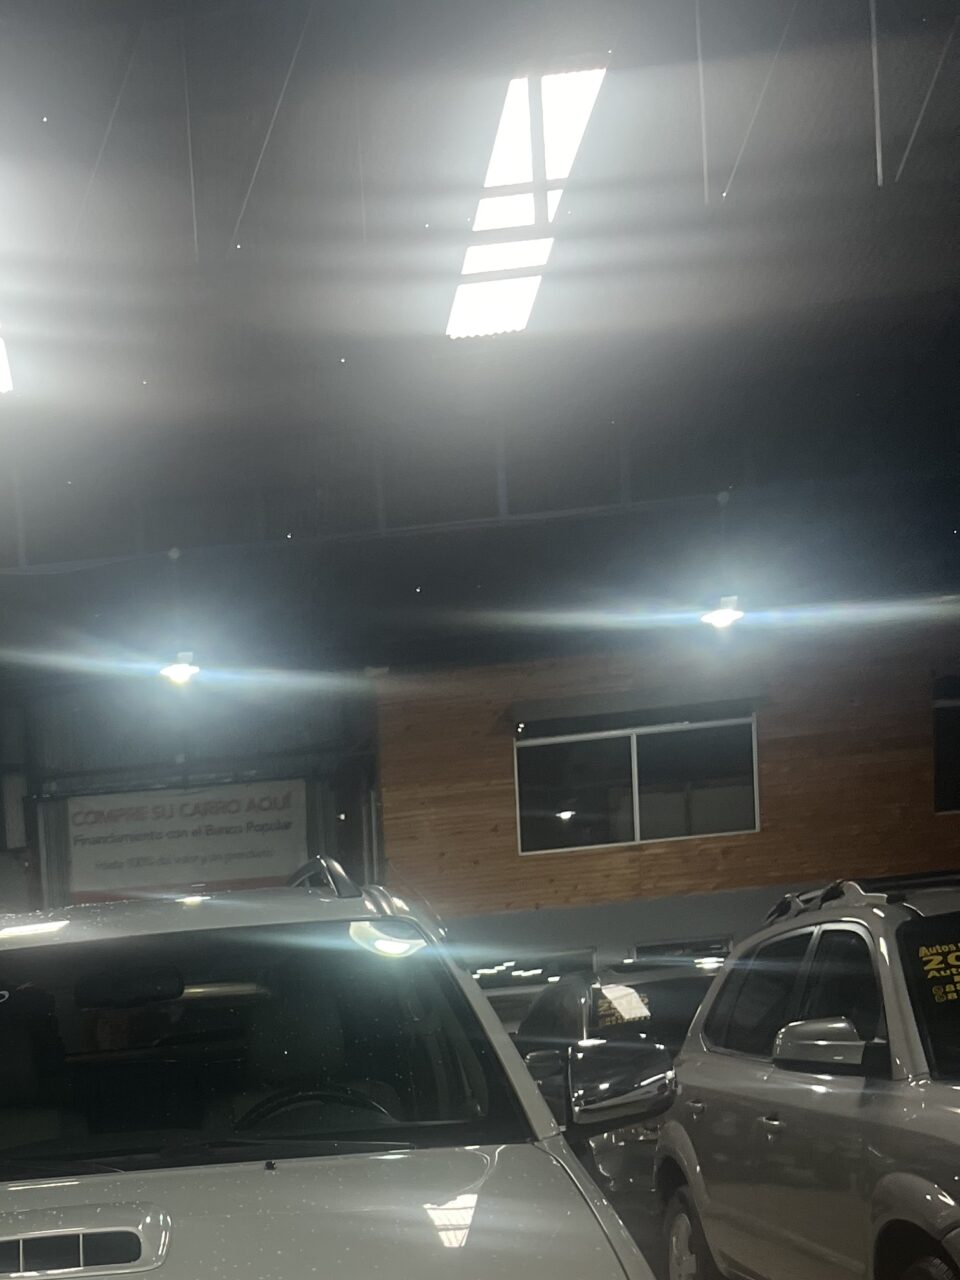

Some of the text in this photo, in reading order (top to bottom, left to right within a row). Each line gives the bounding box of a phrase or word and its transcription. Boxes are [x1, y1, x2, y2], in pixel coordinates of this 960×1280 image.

[72, 805, 149, 827] COMPRE
[151, 803, 174, 821] SU
[179, 799, 241, 819] CARRO
